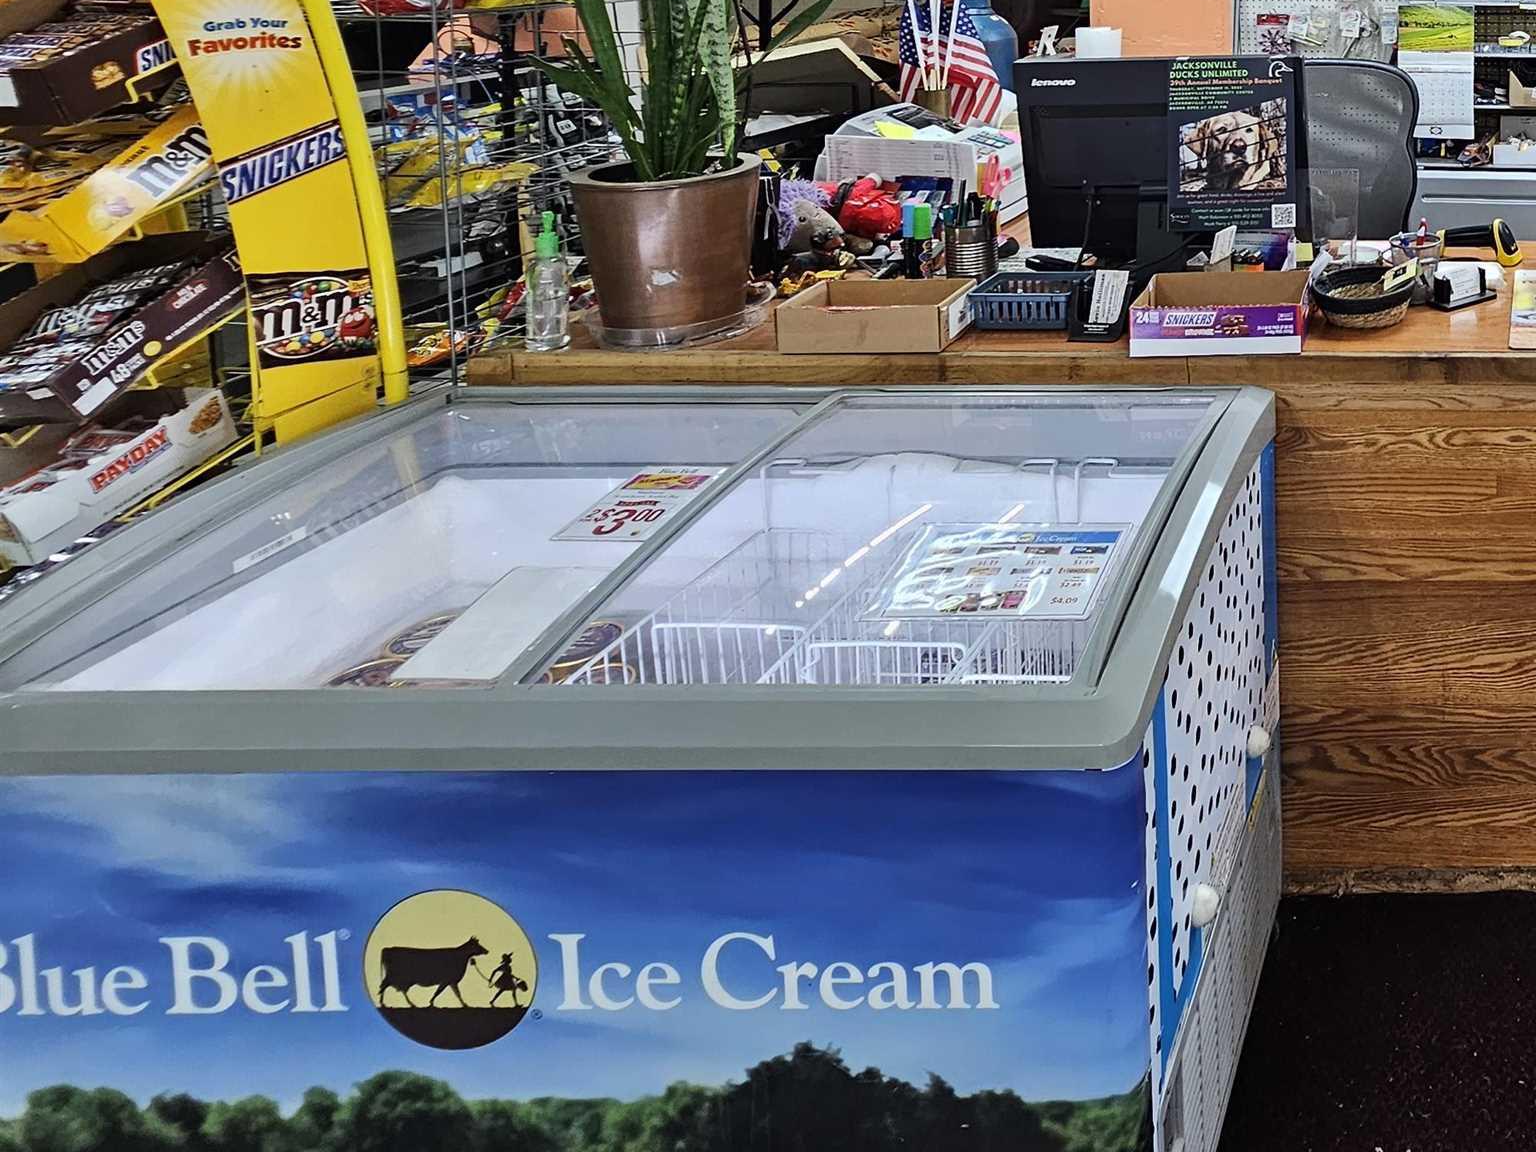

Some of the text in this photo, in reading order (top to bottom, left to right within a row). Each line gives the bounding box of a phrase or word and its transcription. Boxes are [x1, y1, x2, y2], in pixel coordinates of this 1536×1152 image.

[203, 17, 289, 33] Grab Your
[187, 32, 303, 57] Favorites
[1172, 61, 1237, 70] JACKSONVILLE
[1169, 70, 1249, 78] DUCKS UNLIMITED
[1031, 78, 1076, 86] lenovo
[1212, 78, 1253, 86] Membership
[1136, 312, 1150, 324] 24
[1165, 313, 1213, 325] SNICKERS
[109, 363, 130, 384] 48
[88, 425, 169, 494] PAYDAY
[160, 930, 350, 1016] Bell
[547, 932, 682, 1011] Ice
[700, 932, 1000, 1013] Cream
